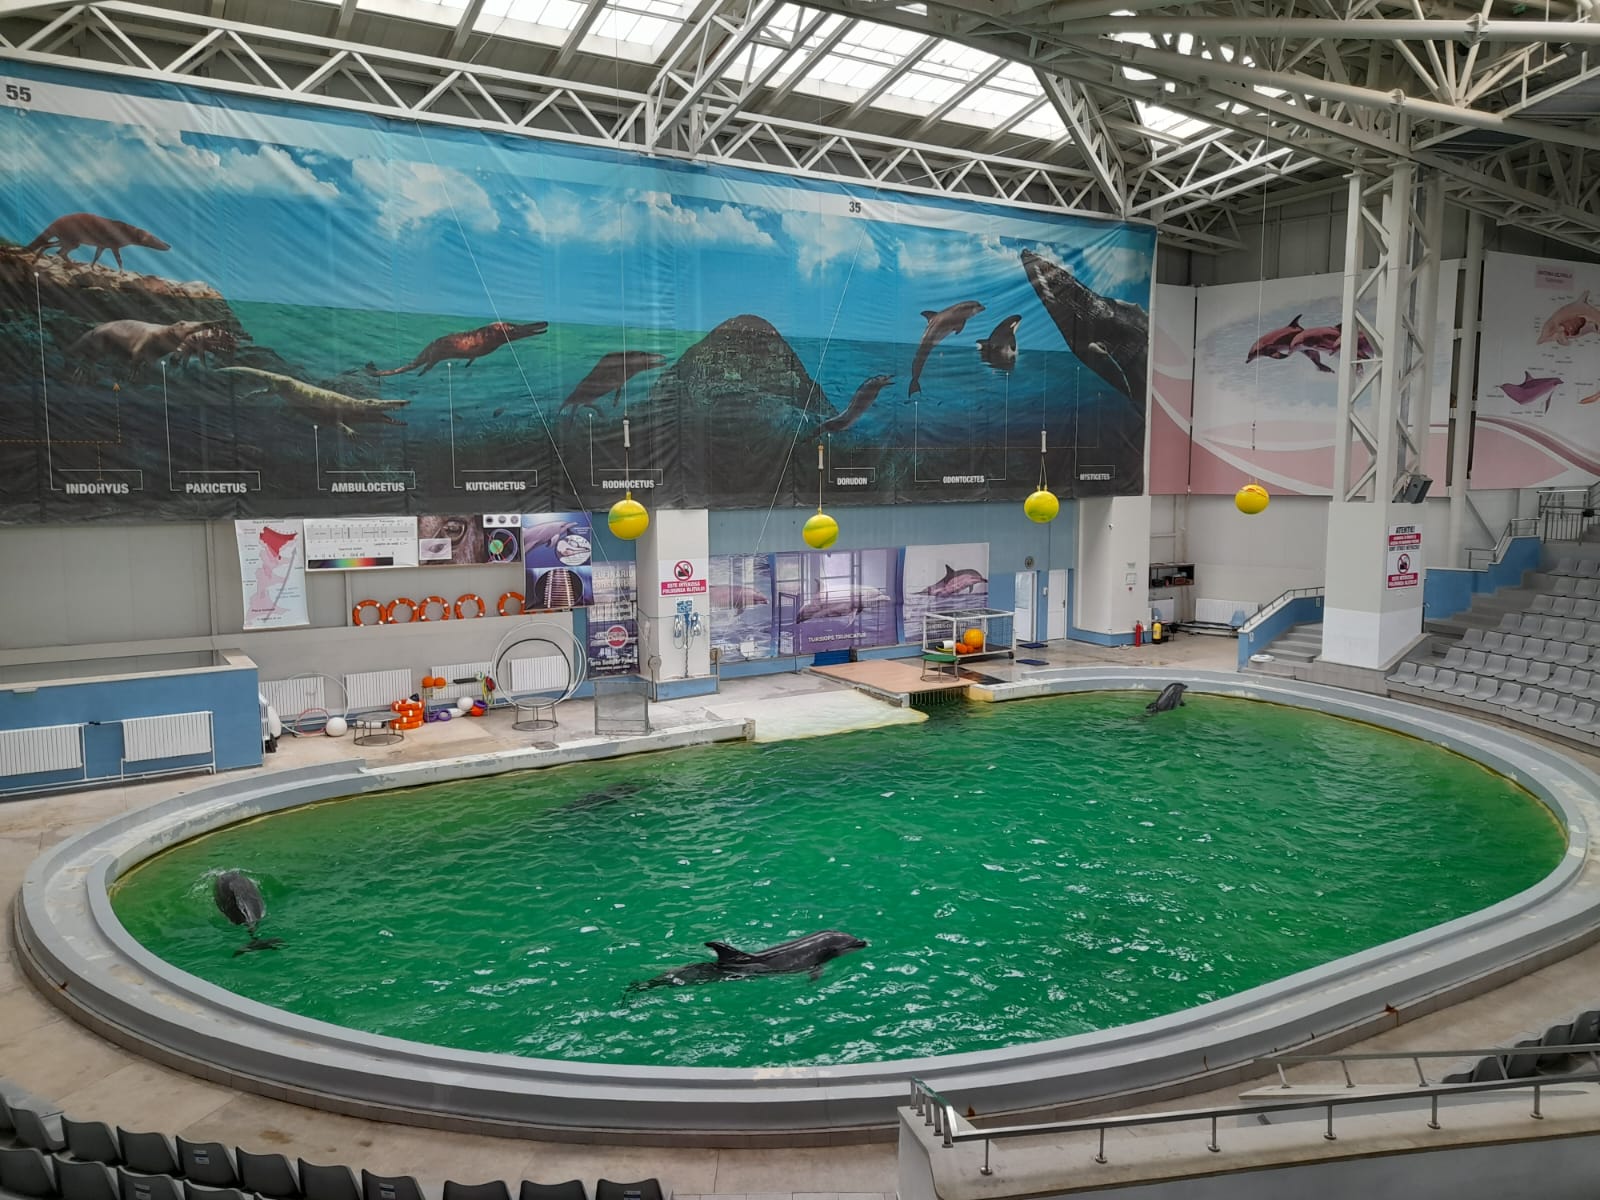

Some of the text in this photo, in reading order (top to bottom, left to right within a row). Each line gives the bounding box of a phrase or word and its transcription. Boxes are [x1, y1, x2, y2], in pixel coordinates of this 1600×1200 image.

[6, 84, 31, 102] 55
[849, 201, 862, 213] 35
[602, 480, 655, 489] RODHOCETUS
[836, 477, 868, 486] DORUDON
[942, 475, 985, 484] ODONTOCETES
[65, 483, 129, 494] INDOHYUS
[185, 483, 247, 494] PAKICETUS
[331, 482, 405, 493] AMBULOCETUS
[465, 481, 526, 491] KUTCHICETUS
